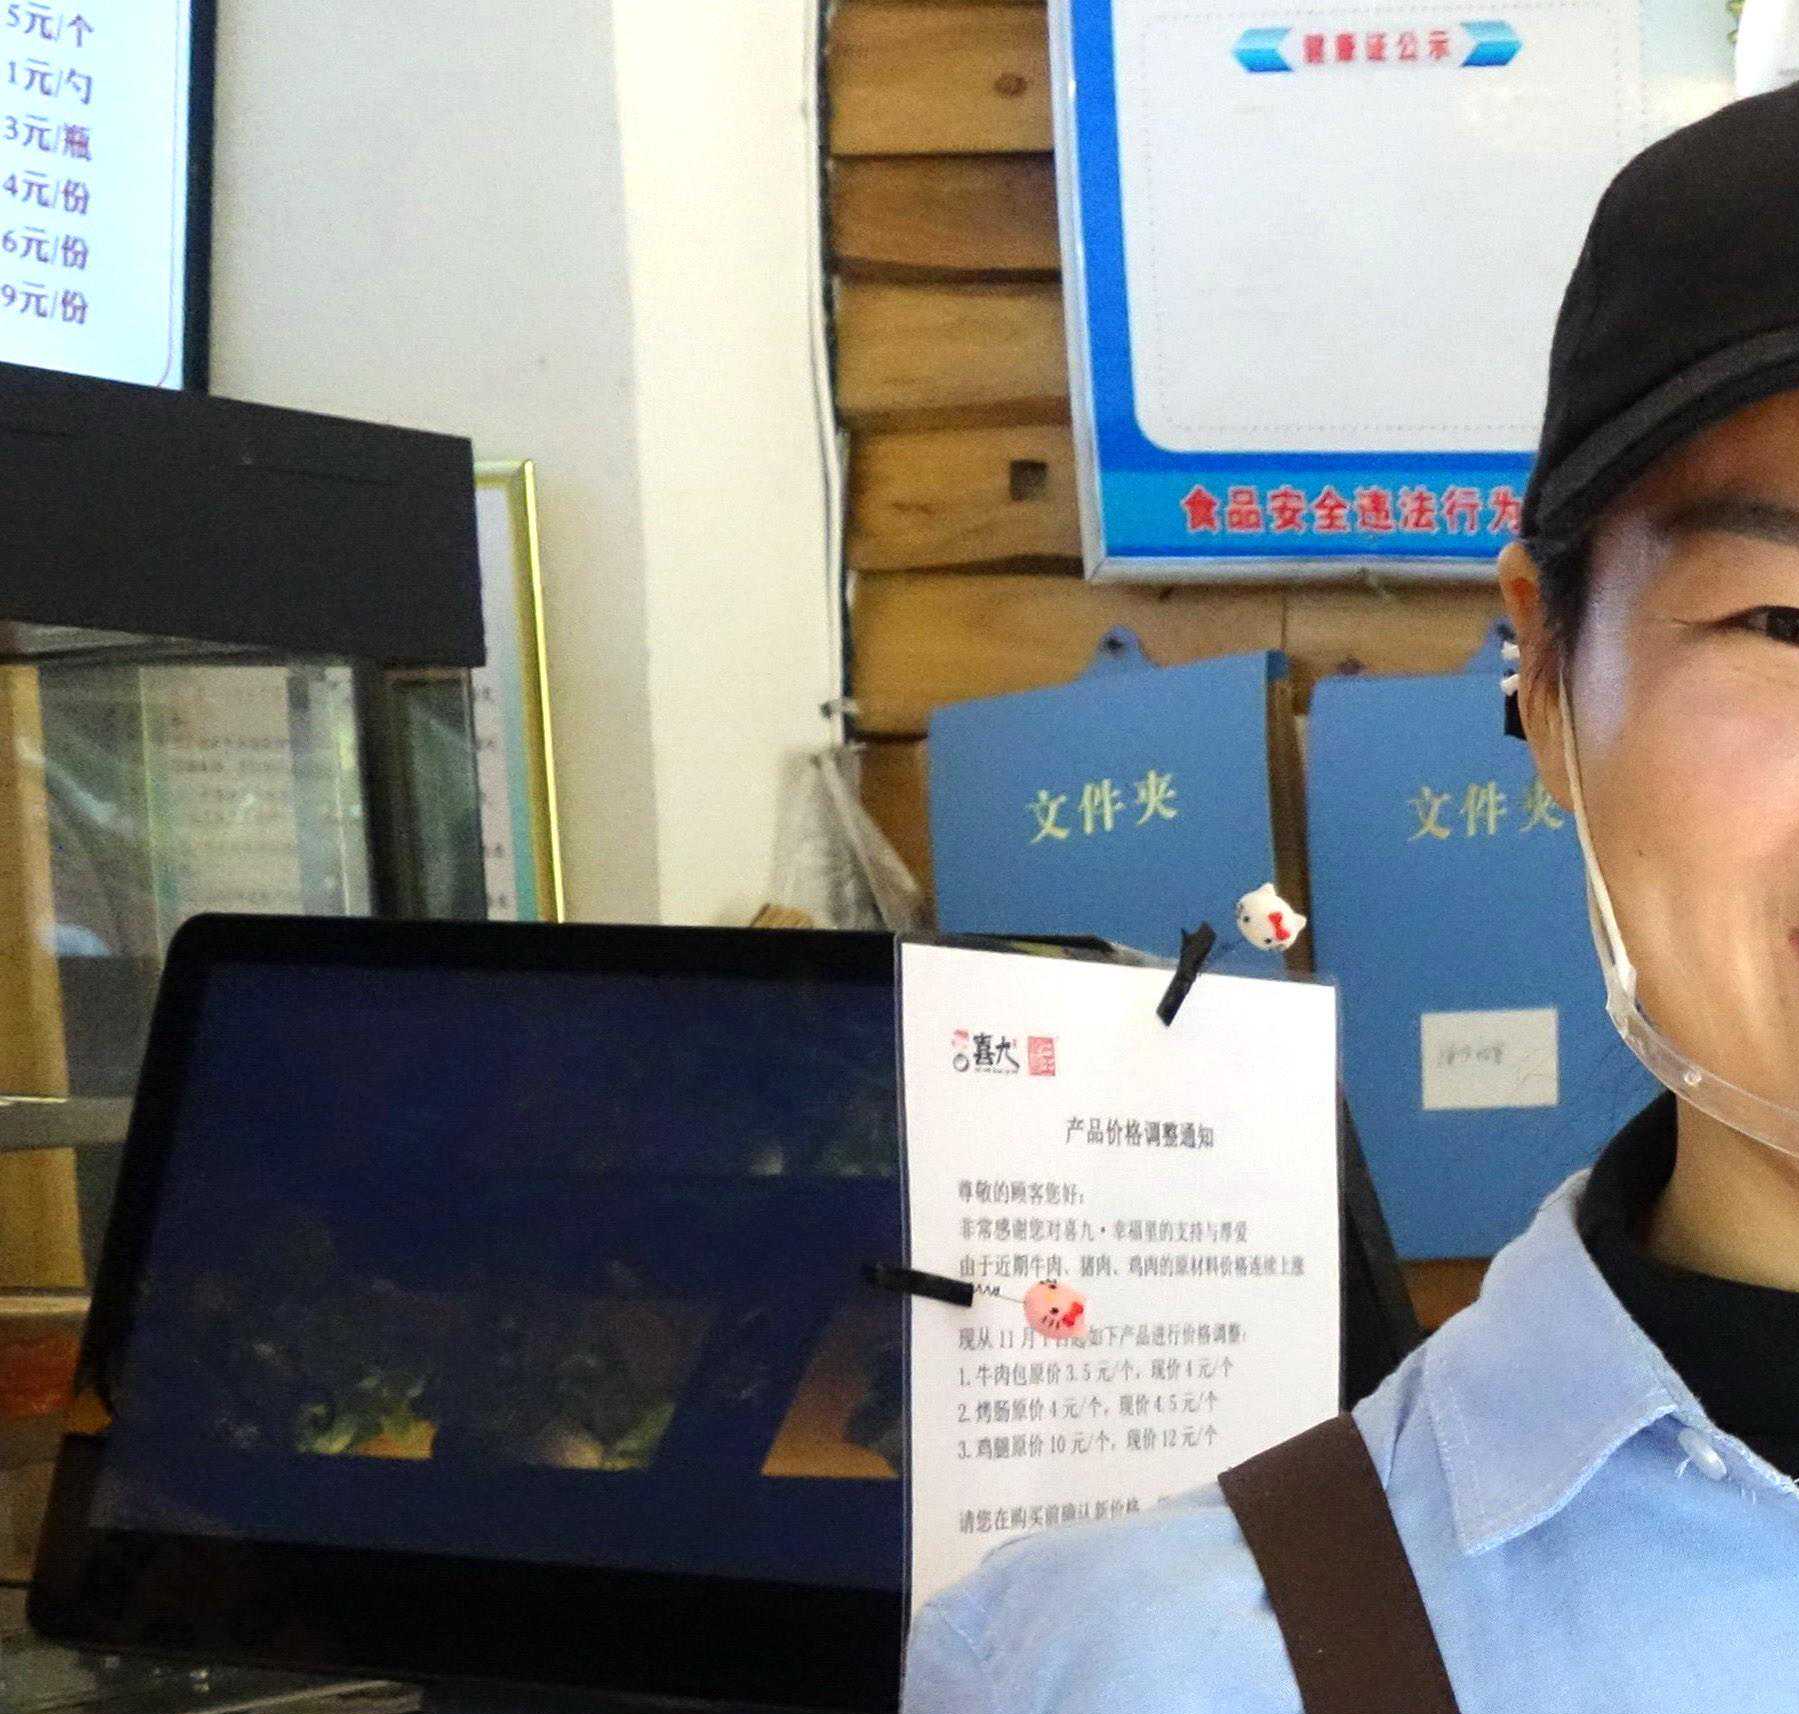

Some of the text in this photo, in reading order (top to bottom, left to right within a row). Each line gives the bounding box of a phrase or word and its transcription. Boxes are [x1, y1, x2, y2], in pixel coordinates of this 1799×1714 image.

[7, 57, 93, 105] 1元/勺
[2, 169, 89, 215] 4元/份
[1, 225, 88, 271] 6元/份
[0, 280, 87, 325] 9元/份
[1179, 482, 1523, 535] 食品安全违法行为
[1029, 768, 1179, 844] 文件夹
[1406, 778, 1564, 842] 文件夹
[1065, 1115, 1215, 1149] 产品价格调整通知
